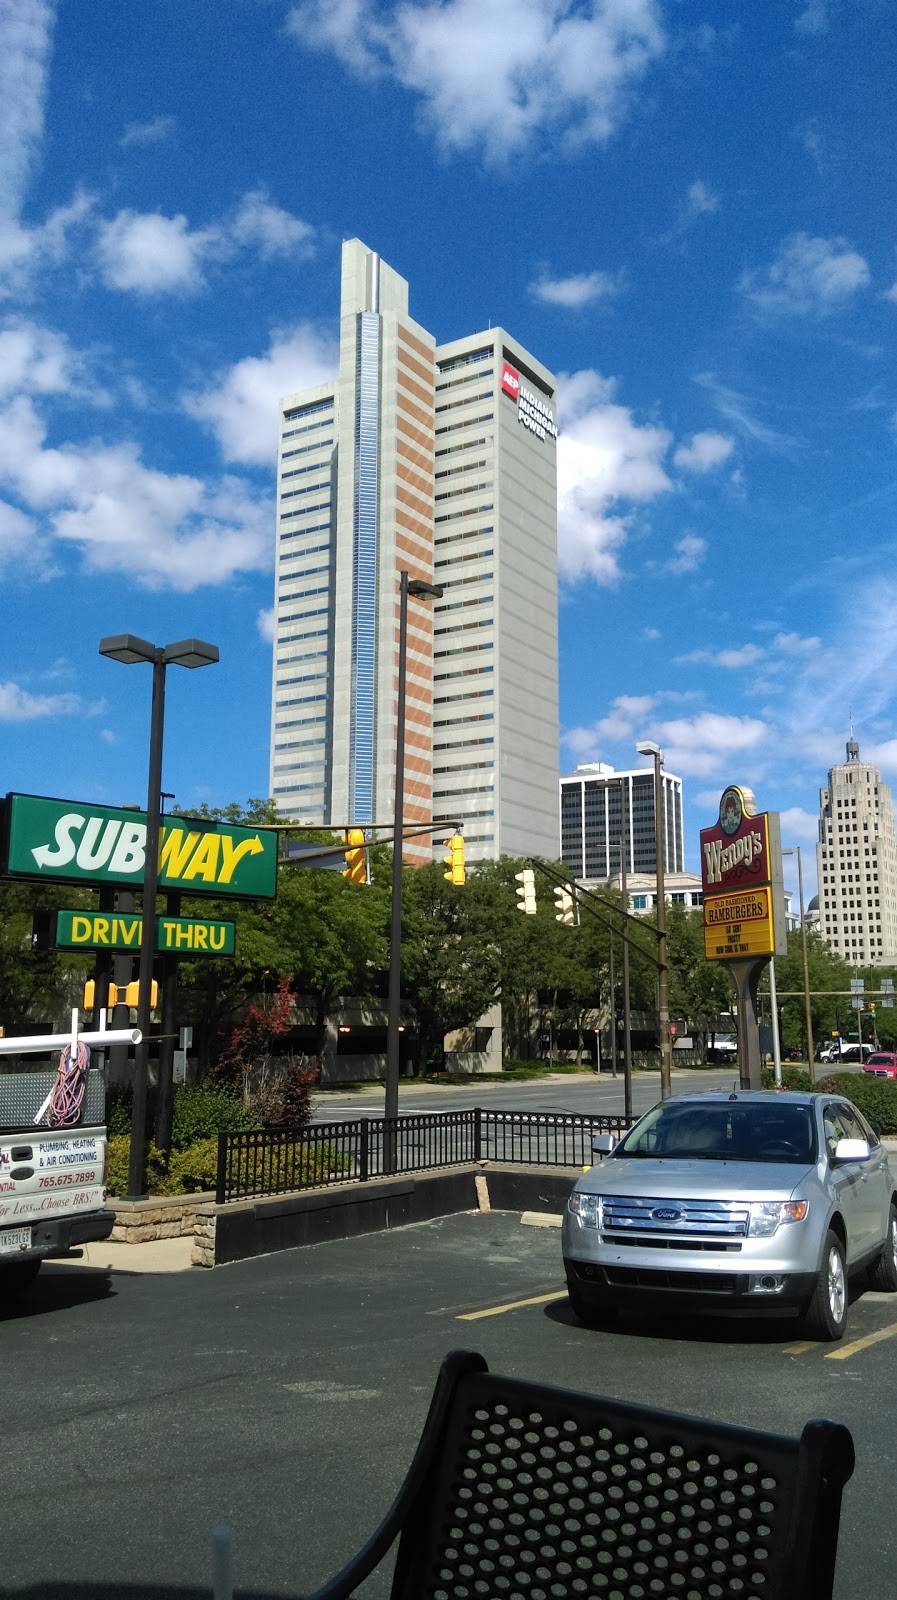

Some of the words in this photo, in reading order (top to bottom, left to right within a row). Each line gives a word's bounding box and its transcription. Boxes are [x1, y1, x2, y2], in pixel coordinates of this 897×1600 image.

[503, 371, 518, 390] AEP
[520, 386, 553, 422] INDIANA
[518, 409, 546, 440] POWER
[519, 398, 558, 438] MICHIGAN
[31, 813, 264, 884] SUBWAY
[708, 902, 763, 922] HAMBURGERS
[163, 922, 226, 950] THRU
[72, 1138, 96, 1149] HEATING
[39, 1158, 44, 1167] &
[46, 1156, 57, 1167] AIR
[58, 1151, 97, 1165] CONDITIONING
[39, 1171, 96, 1188] 765.675.7899
